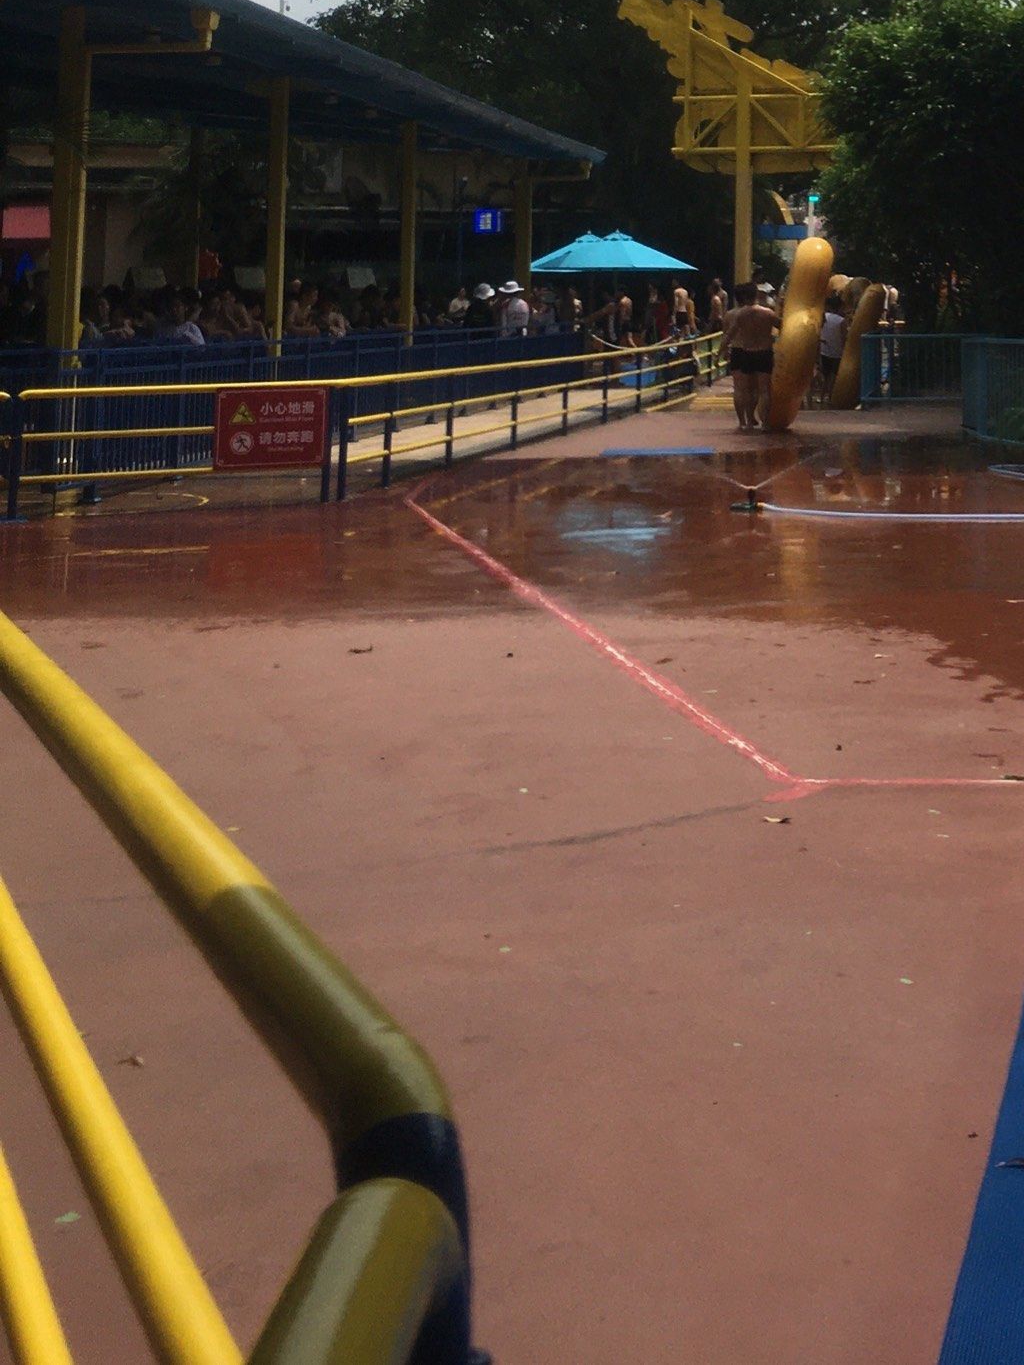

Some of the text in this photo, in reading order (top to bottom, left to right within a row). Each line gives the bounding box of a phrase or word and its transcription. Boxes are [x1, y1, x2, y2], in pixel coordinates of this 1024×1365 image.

[260, 401, 315, 415] 小心地滑
[259, 430, 314, 444] 请勿奔跑
